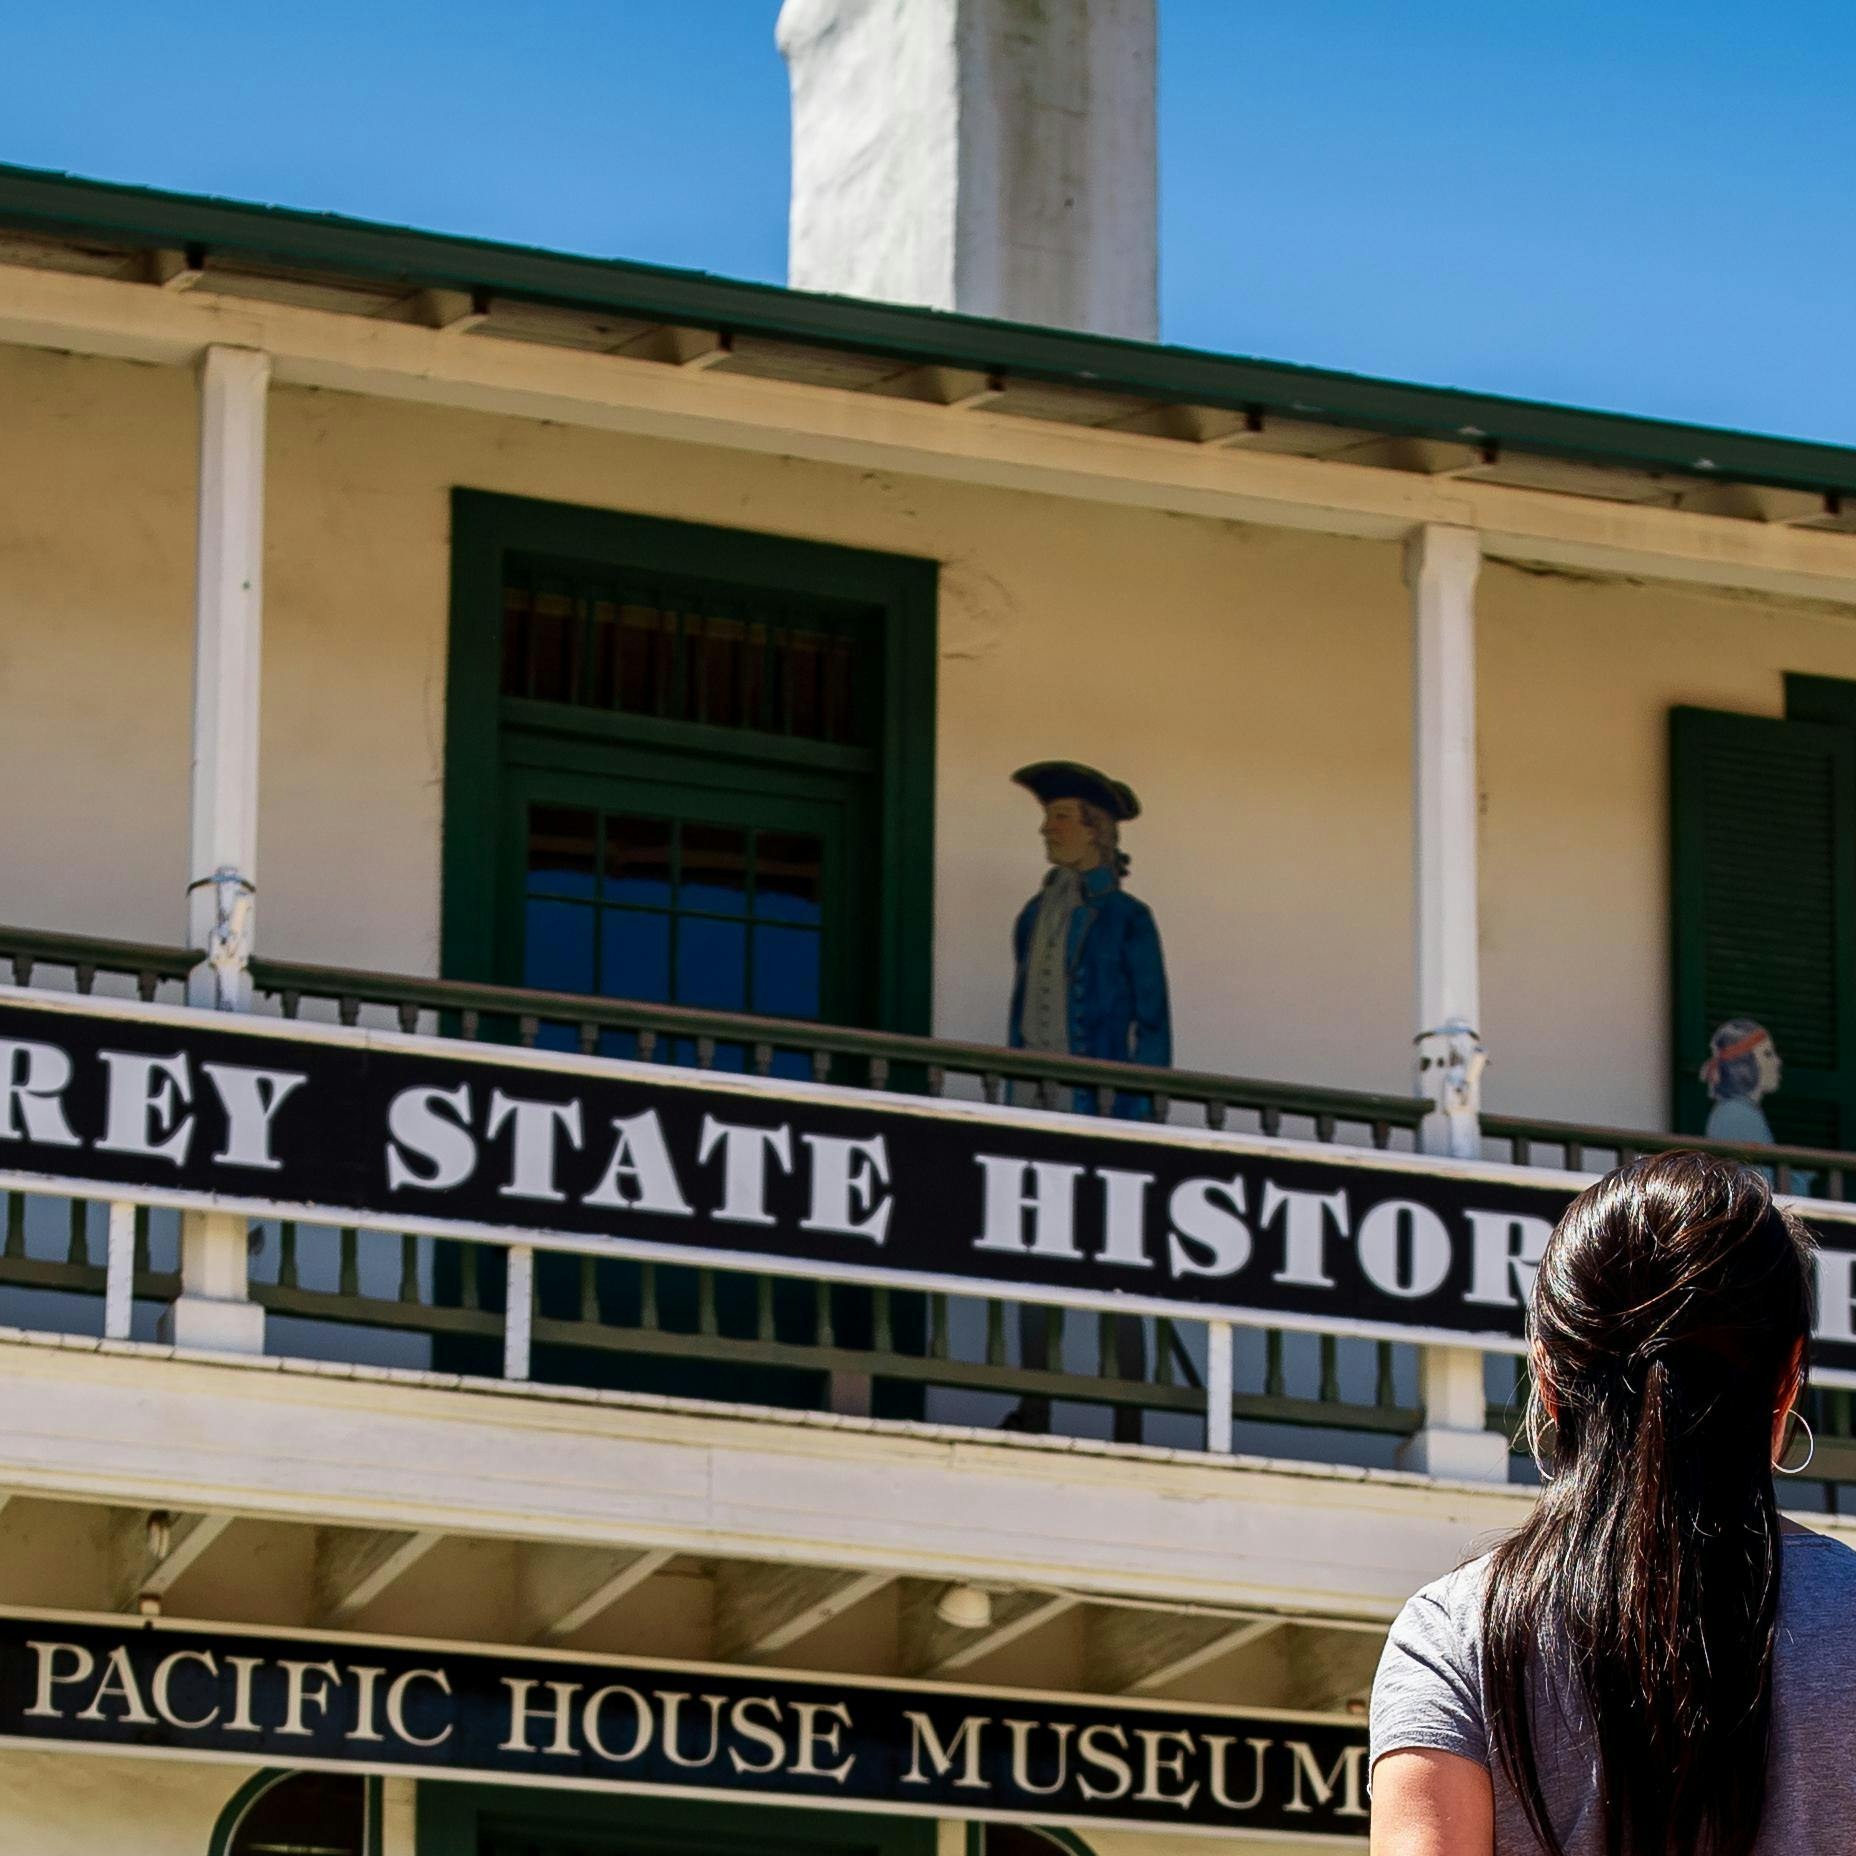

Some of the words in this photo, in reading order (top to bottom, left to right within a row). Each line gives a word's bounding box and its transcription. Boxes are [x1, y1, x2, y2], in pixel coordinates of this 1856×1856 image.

[385, 1080, 895, 1246] STATE
[972, 1152, 1558, 1308] HISTOR
[23, 1639, 454, 1748] PACIFIC
[498, 1676, 857, 1785] HOUSE
[899, 1710, 1371, 1817] MUSEUM
